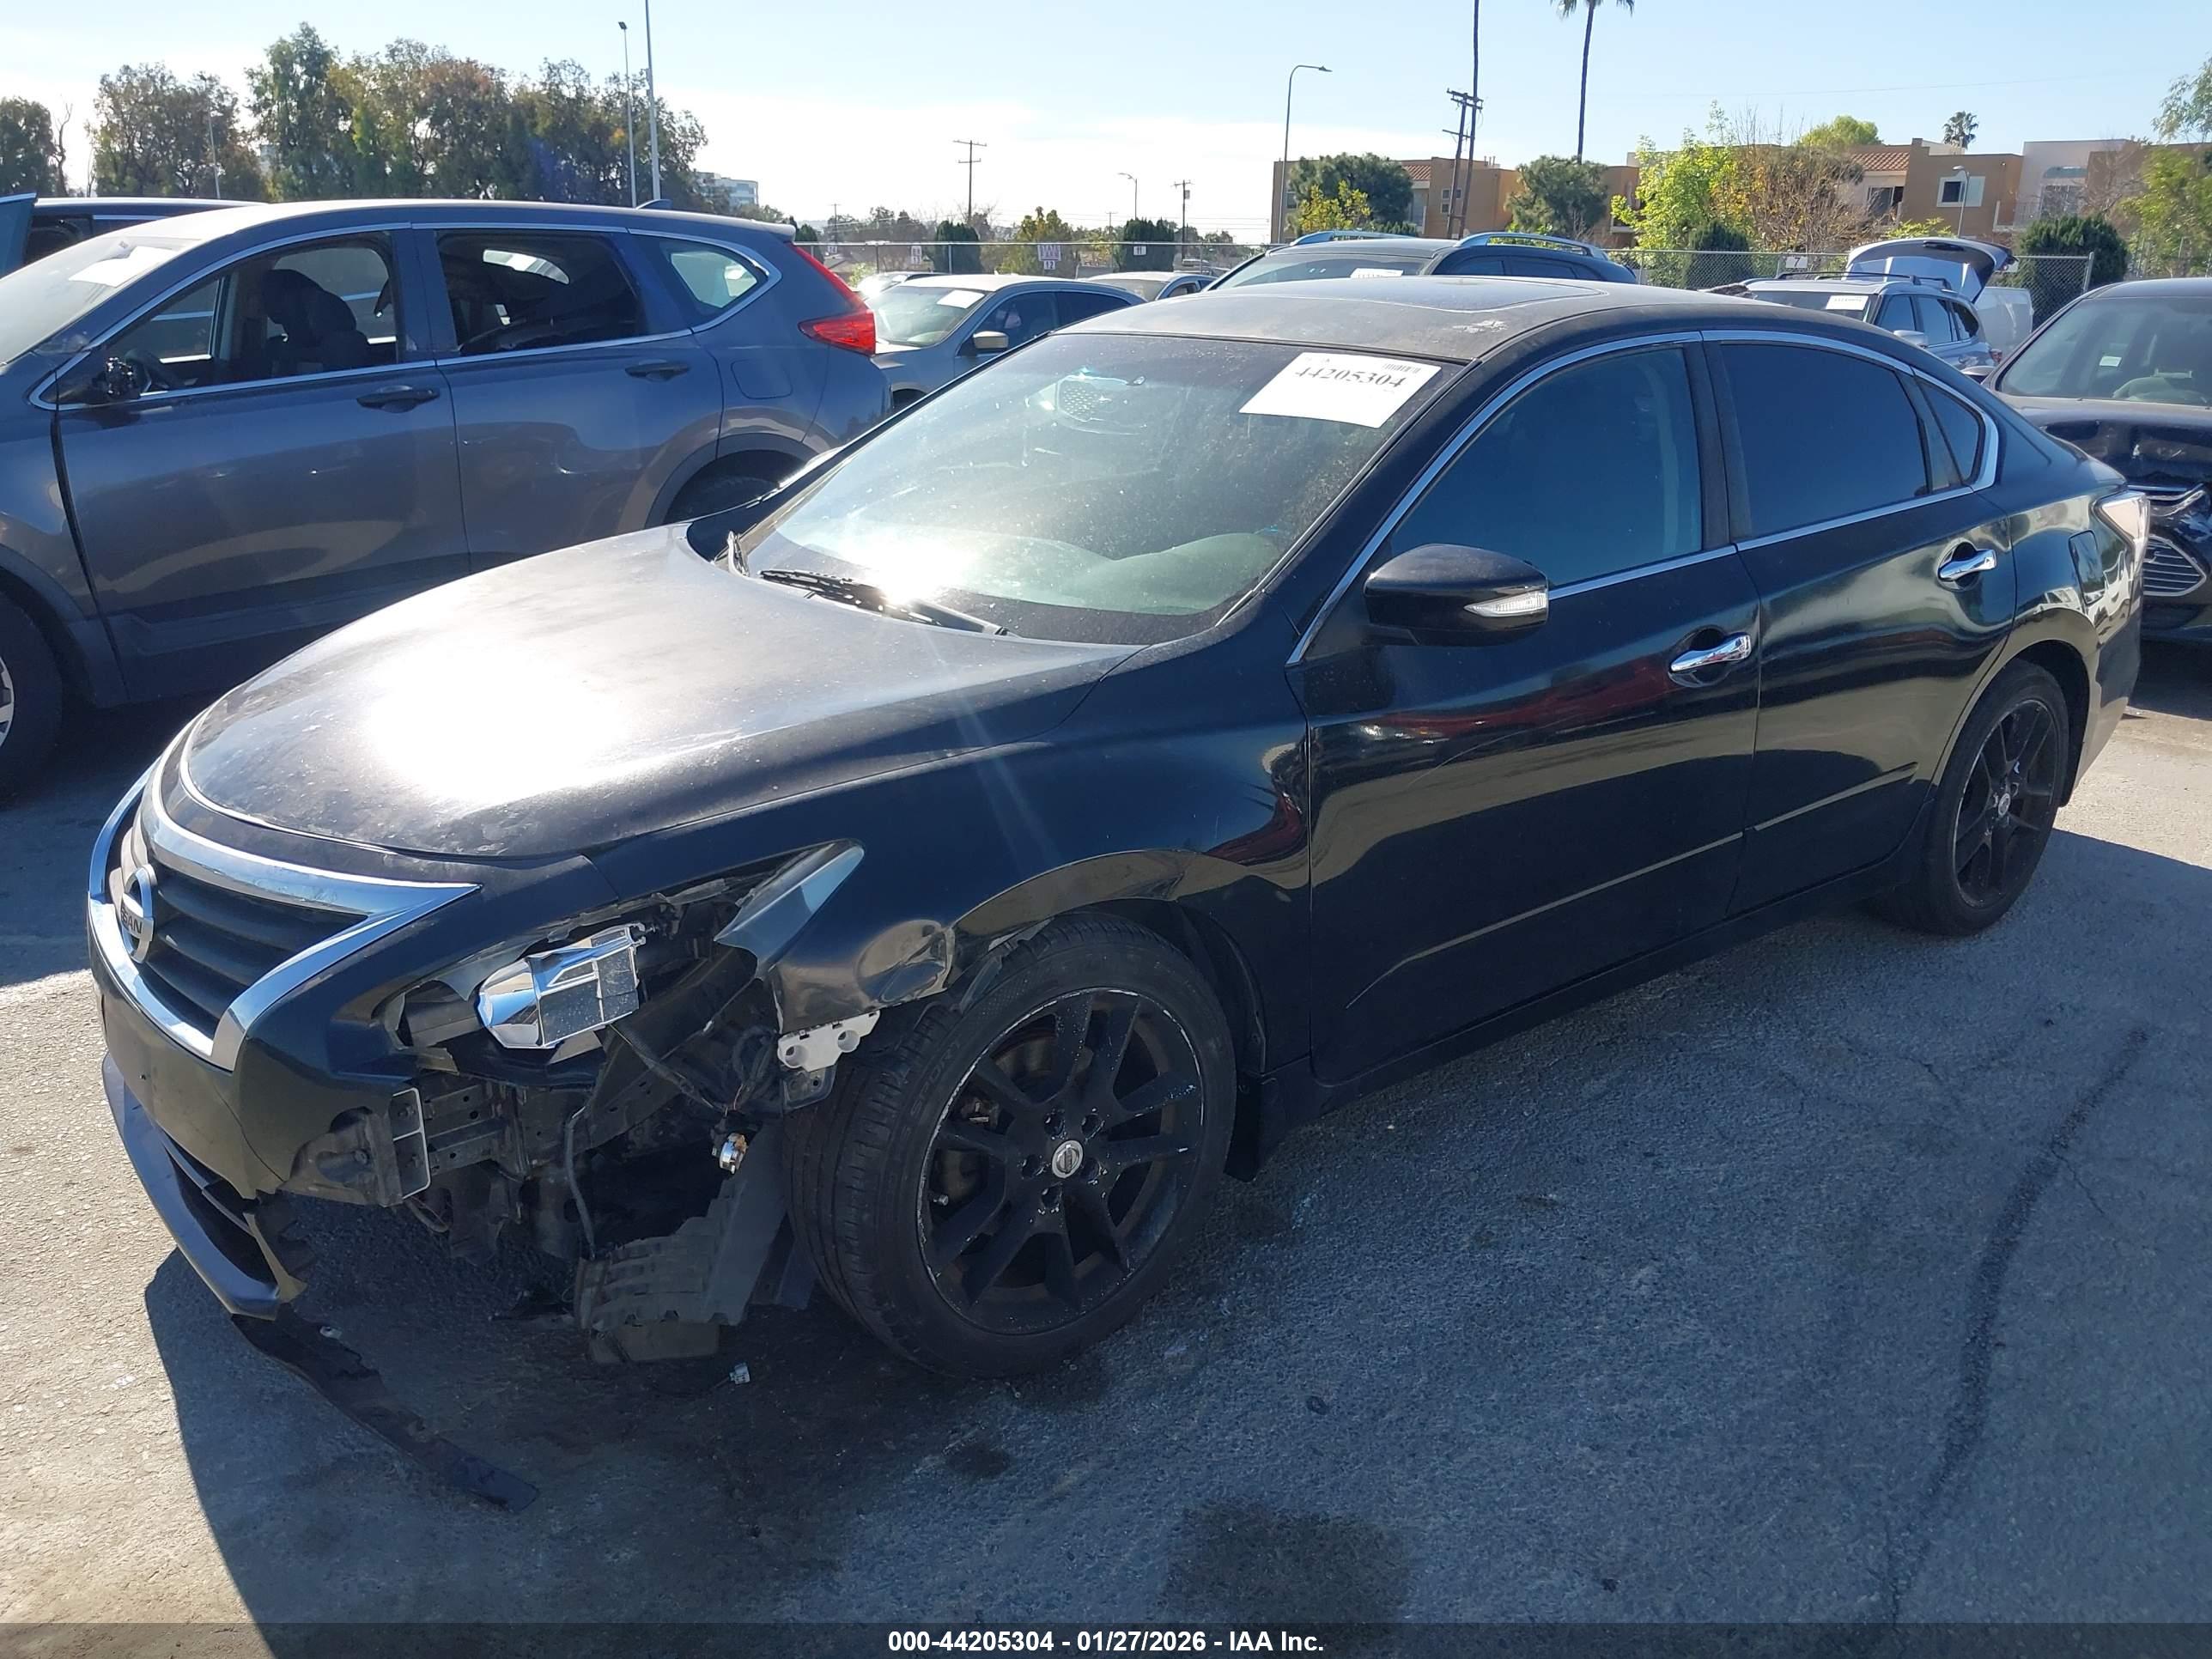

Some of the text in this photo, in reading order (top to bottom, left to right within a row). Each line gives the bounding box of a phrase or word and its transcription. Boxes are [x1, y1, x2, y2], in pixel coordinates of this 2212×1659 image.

[1045, 260, 1054, 270] 12
[1794, 257, 1801, 267] 7
[1295, 367, 1407, 389] 44205304
